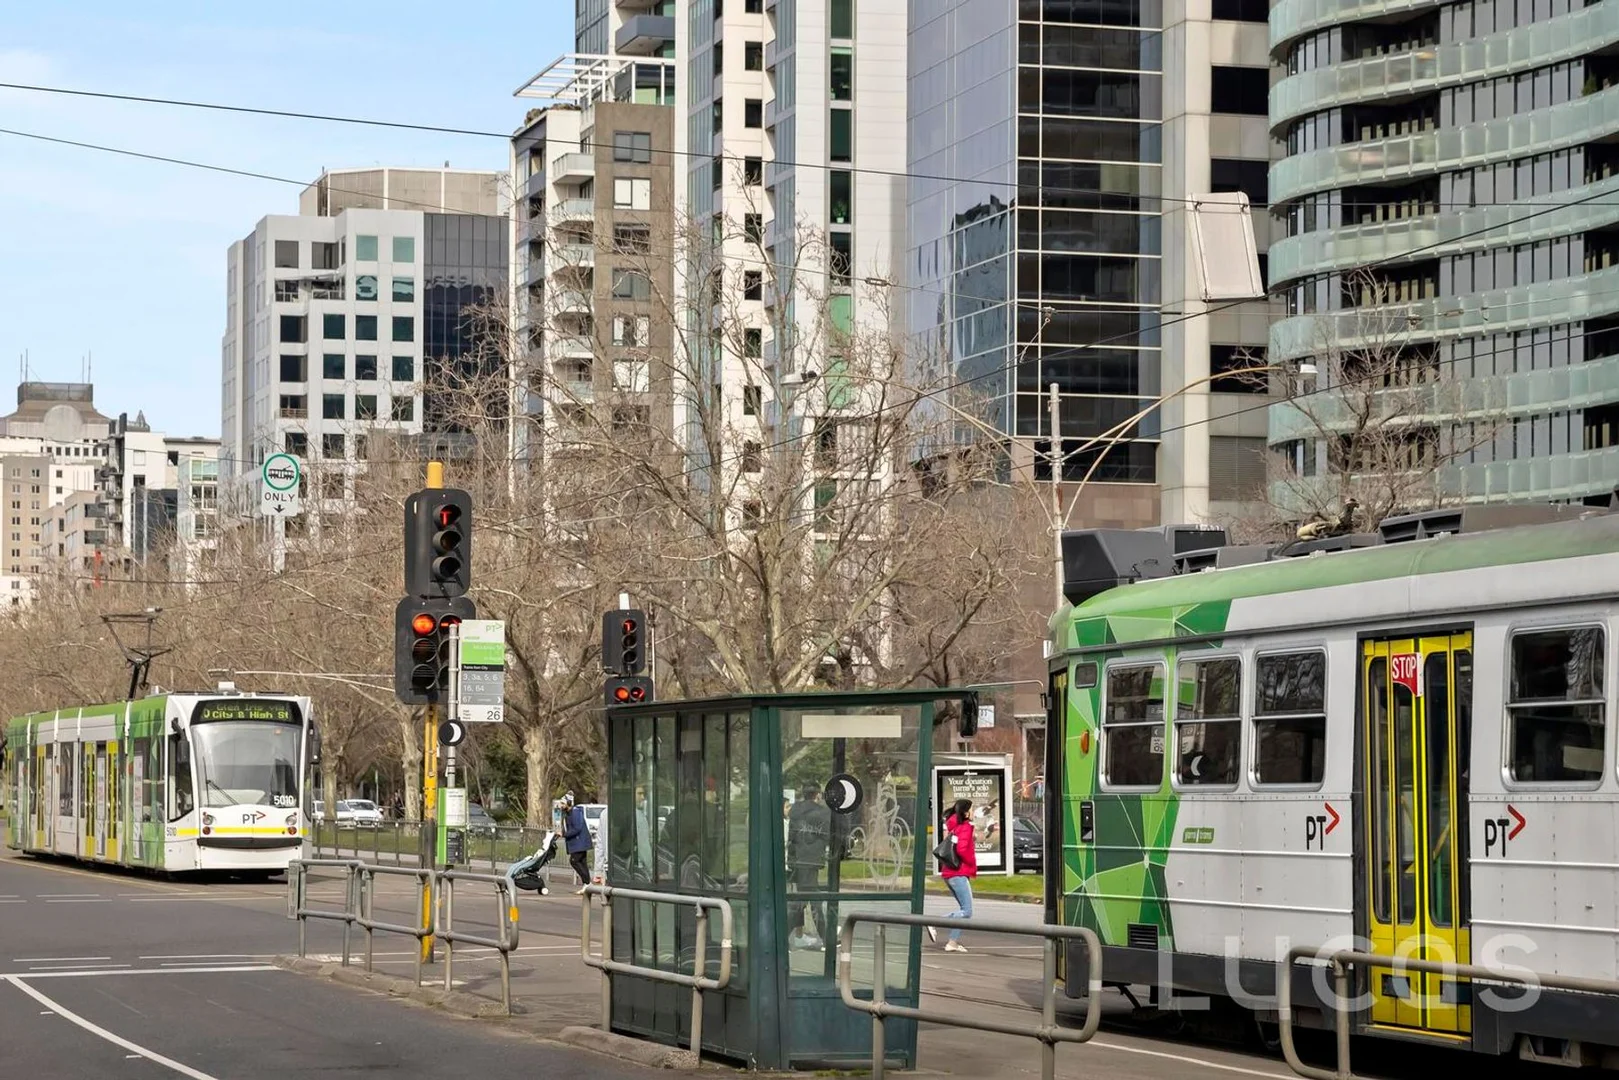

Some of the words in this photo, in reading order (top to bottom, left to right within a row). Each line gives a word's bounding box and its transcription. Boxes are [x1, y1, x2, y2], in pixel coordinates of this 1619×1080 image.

[264, 491, 295, 502] ONLY
[1391, 656, 1417, 679] STOP
[212, 711, 233, 719] City
[249, 711, 273, 719] High
[277, 711, 289, 719] St
[486, 710, 501, 720] 26
[953, 784, 970, 792] turns
[273, 795, 294, 806] 5010
